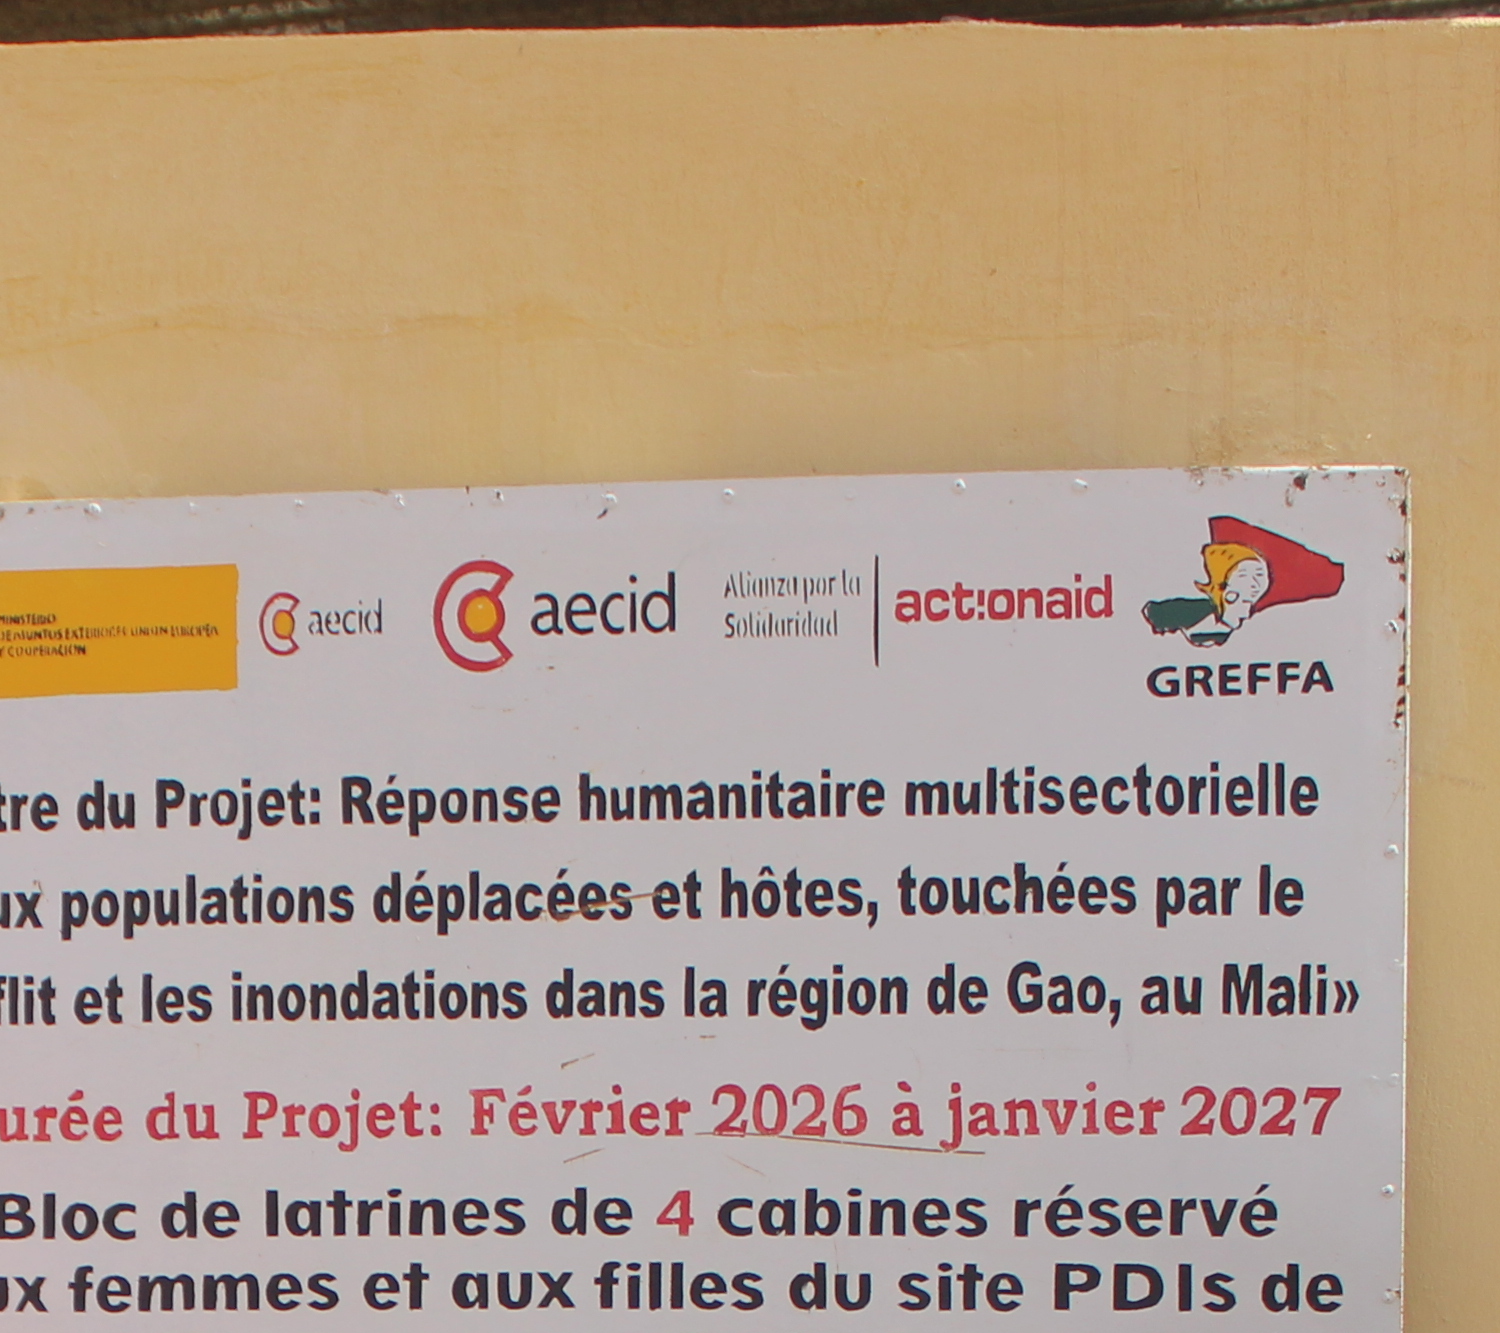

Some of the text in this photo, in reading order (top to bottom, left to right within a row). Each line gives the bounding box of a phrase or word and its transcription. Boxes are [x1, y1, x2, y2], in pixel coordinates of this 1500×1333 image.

[307, 598, 383, 636] aecid
[530, 570, 677, 637] aecid
[803, 575, 836, 604] por
[841, 568, 861, 597] la
[1146, 660, 1334, 698] GREFFA
[76, 779, 136, 832] du
[155, 777, 321, 841] Projet:
[341, 774, 561, 838] Réponse
[578, 768, 885, 822] humanitaire
[904, 760, 1319, 817] multisectorielle
[60, 873, 355, 942] populations
[372, 867, 633, 937] déplacées
[651, 869, 702, 921] et
[720, 865, 879, 929] hôtes,
[897, 861, 1137, 917] touchées
[1155, 875, 1242, 929] par
[1258, 863, 1305, 918] le
[73, 974, 124, 1026] et
[141, 972, 213, 1025] les
[231, 968, 528, 1023] inondations
[545, 967, 665, 1020] dans
[683, 965, 728, 1018] la
[747, 963, 909, 1032] région
[927, 962, 989, 1016] de
[1006, 960, 1122, 1029] Gao,
[1140, 975, 1203, 1016] au
[145, 1091, 220, 1142] du
[242, 1088, 442, 1153] Projet:
[469, 1083, 692, 1137] Février
[711, 1083, 868, 1138] 2026
[891, 1080, 924, 1137] à
[938, 1081, 1166, 1152] janvier
[1180, 1085, 1342, 1137] 2027
[160, 1190, 241, 1240] de
[265, 1187, 527, 1238] latrines
[551, 1186, 633, 1237] de
[656, 1189, 695, 1237] 4
[717, 1187, 988, 1238] cabines
[1013, 1183, 1278, 1238] réservé
[67, 1264, 340, 1314] femmes
[362, 1262, 430, 1311] et
[451, 1271, 576, 1311] aux
[593, 1260, 765, 1312] filles
[788, 1261, 872, 1312] du
[898, 1262, 1024, 1313] site
[1053, 1262, 1237, 1313] PDIs
[1261, 1263, 1344, 1313] de
